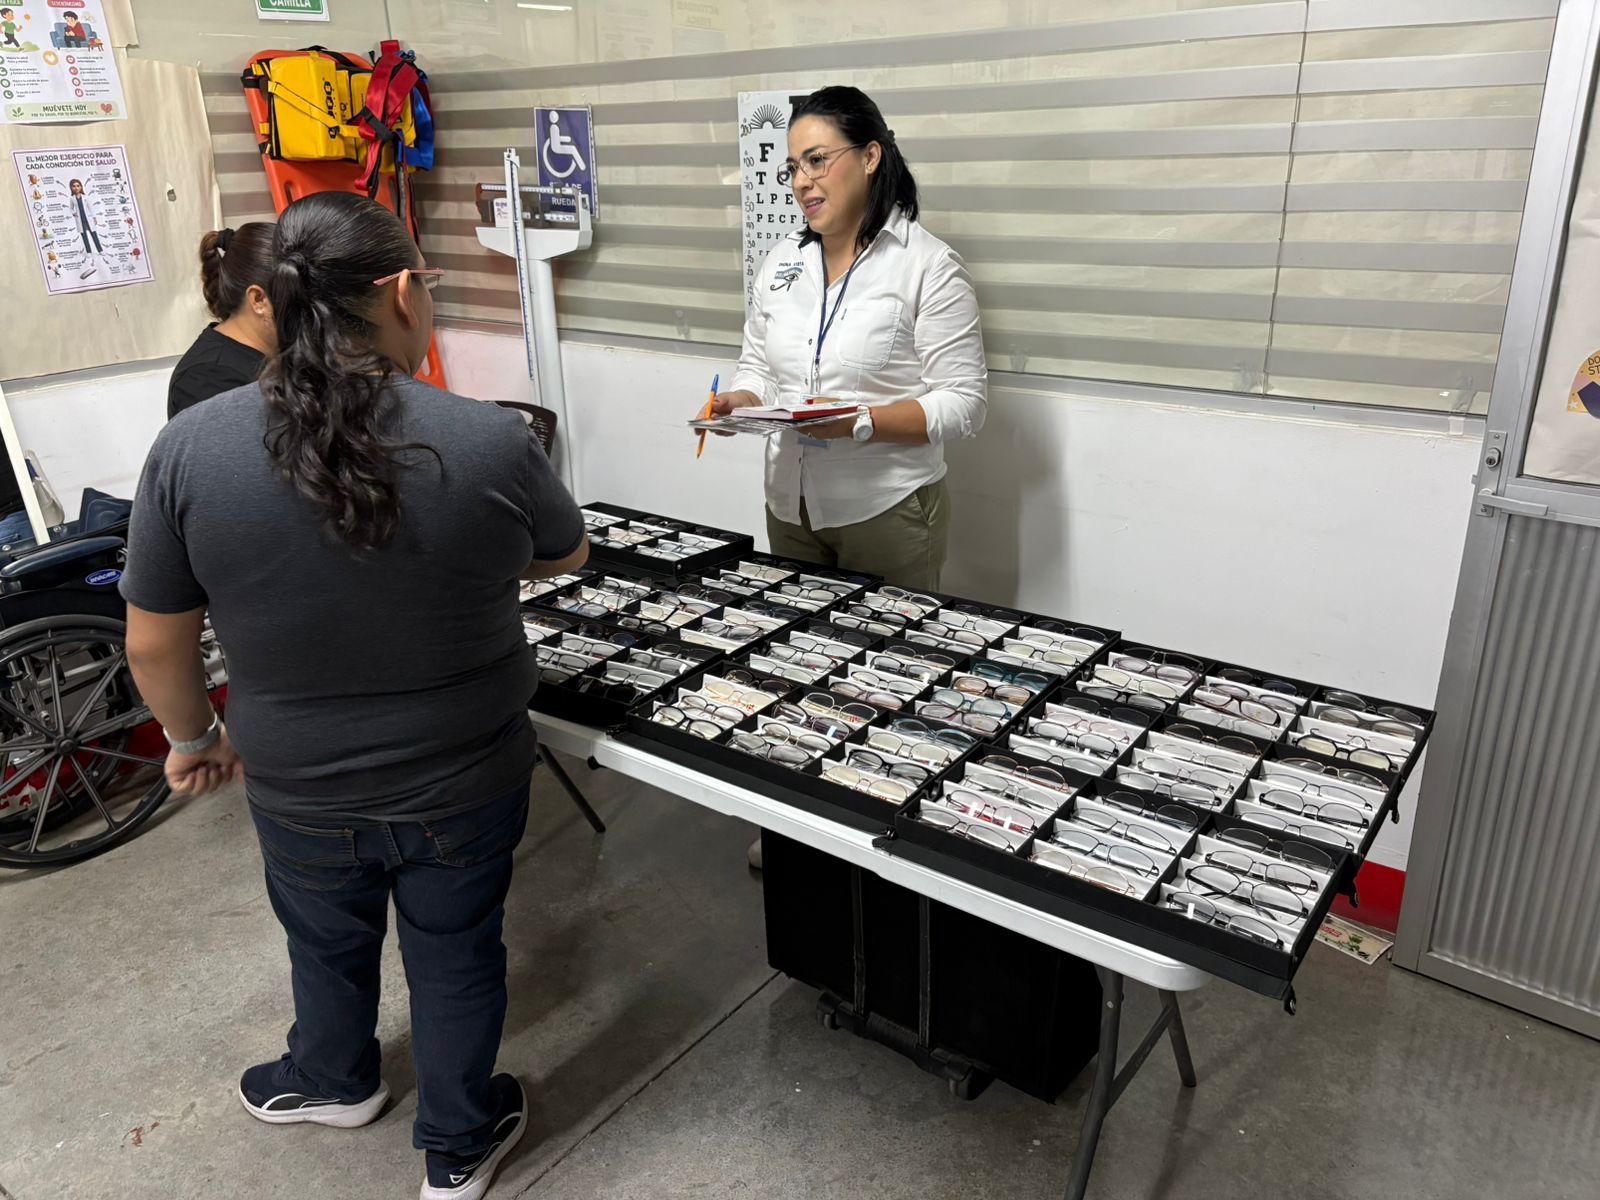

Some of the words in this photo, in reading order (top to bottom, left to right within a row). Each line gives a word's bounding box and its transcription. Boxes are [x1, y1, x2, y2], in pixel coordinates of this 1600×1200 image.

[60, 153, 95, 161] EJERCICIO
[759, 143, 774, 162] F
[25, 163, 45, 171] CADA
[45, 160, 84, 169] CONDICIÓN
[755, 171, 767, 185] T
[551, 196, 577, 206] RUEDA
